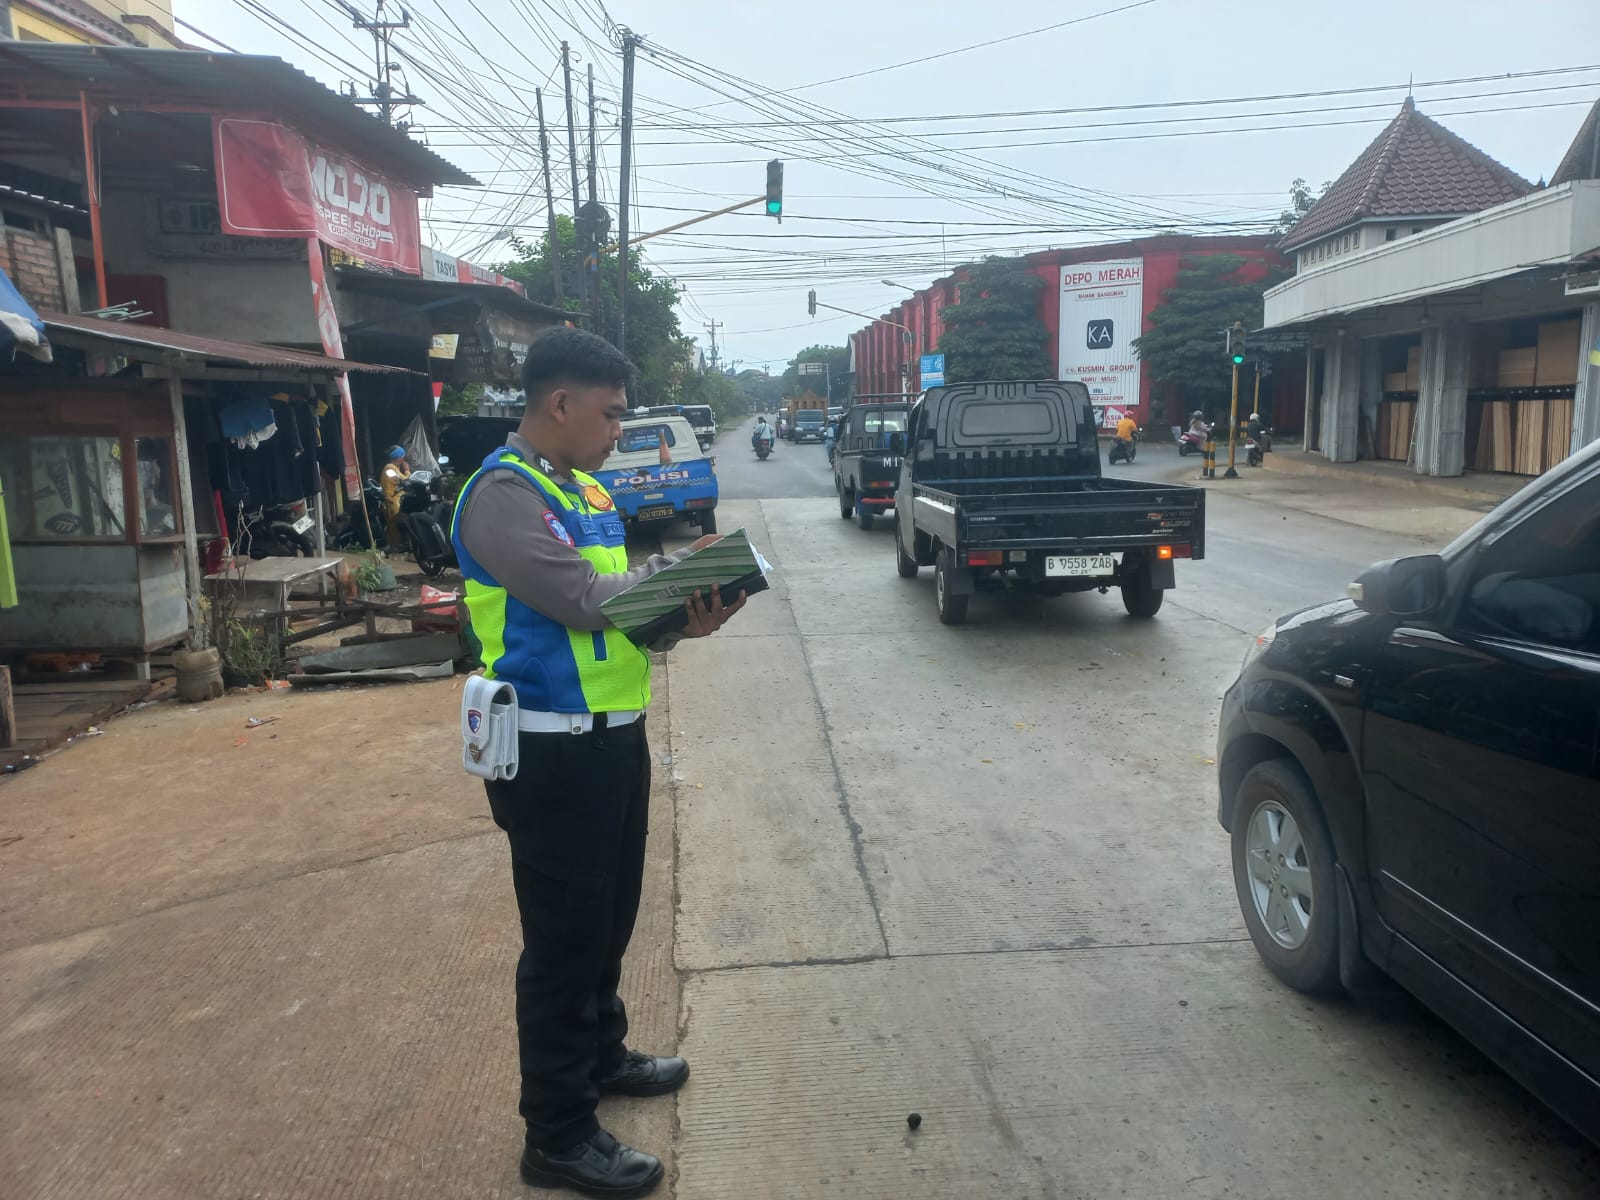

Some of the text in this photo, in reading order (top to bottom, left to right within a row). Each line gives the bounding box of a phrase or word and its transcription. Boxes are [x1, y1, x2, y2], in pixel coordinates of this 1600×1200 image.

[315, 203, 382, 240] SPEE SHOP
[436, 260, 457, 279] TASYA
[1064, 267, 1140, 286] DEPO MERAH
[1088, 326, 1112, 343] KA
[1109, 364, 1135, 372] GROUP
[614, 470, 690, 487] POLISI
[1048, 558, 1055, 570] B
[1090, 557, 1112, 569] ZAB
